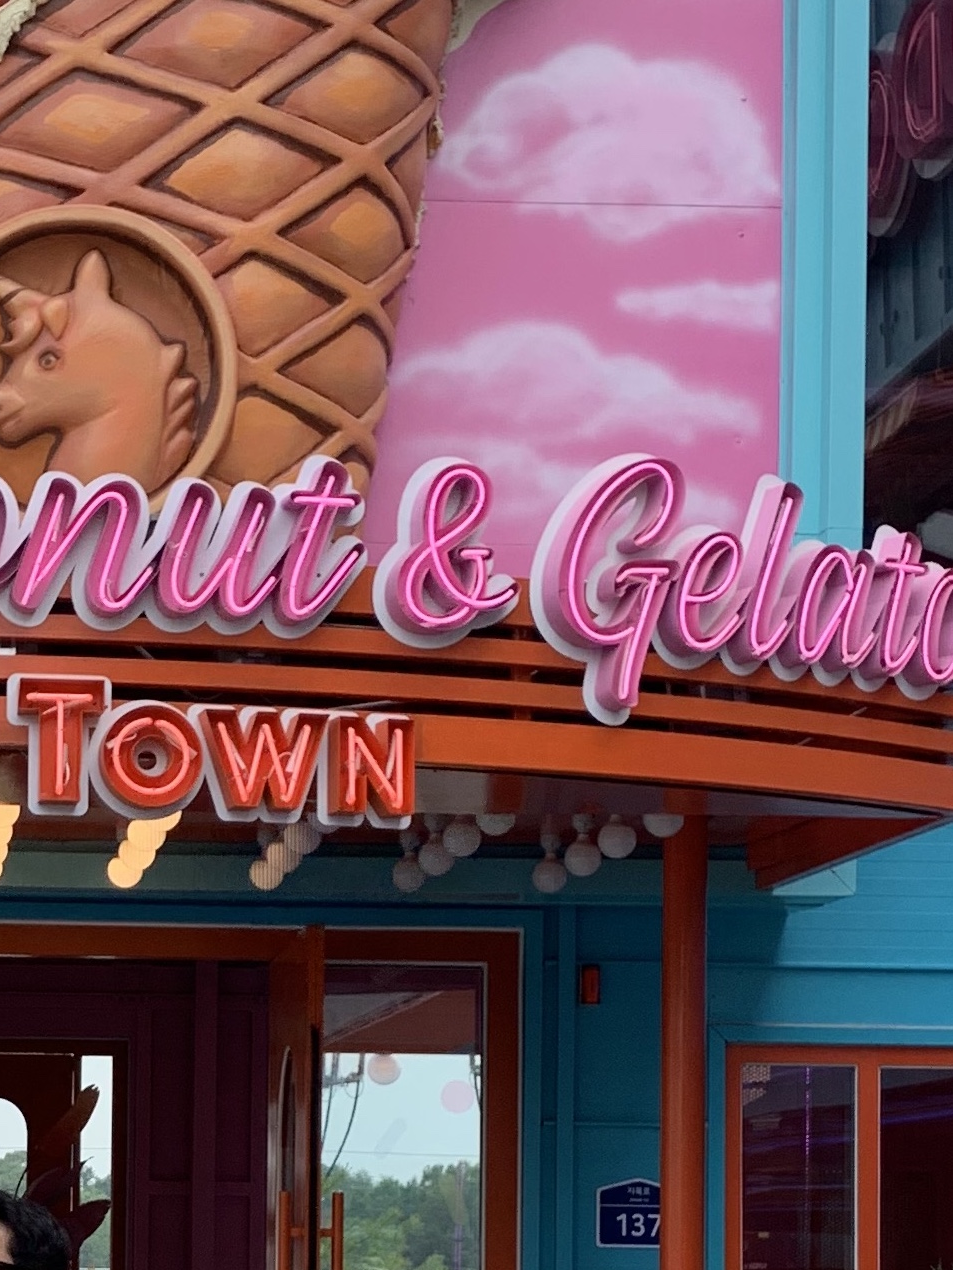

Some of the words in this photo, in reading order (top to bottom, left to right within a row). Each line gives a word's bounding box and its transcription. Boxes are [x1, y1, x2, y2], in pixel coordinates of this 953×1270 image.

[376, 458, 521, 645] &
[7, 676, 415, 827] TOWN
[616, 1213, 660, 1237] 137
